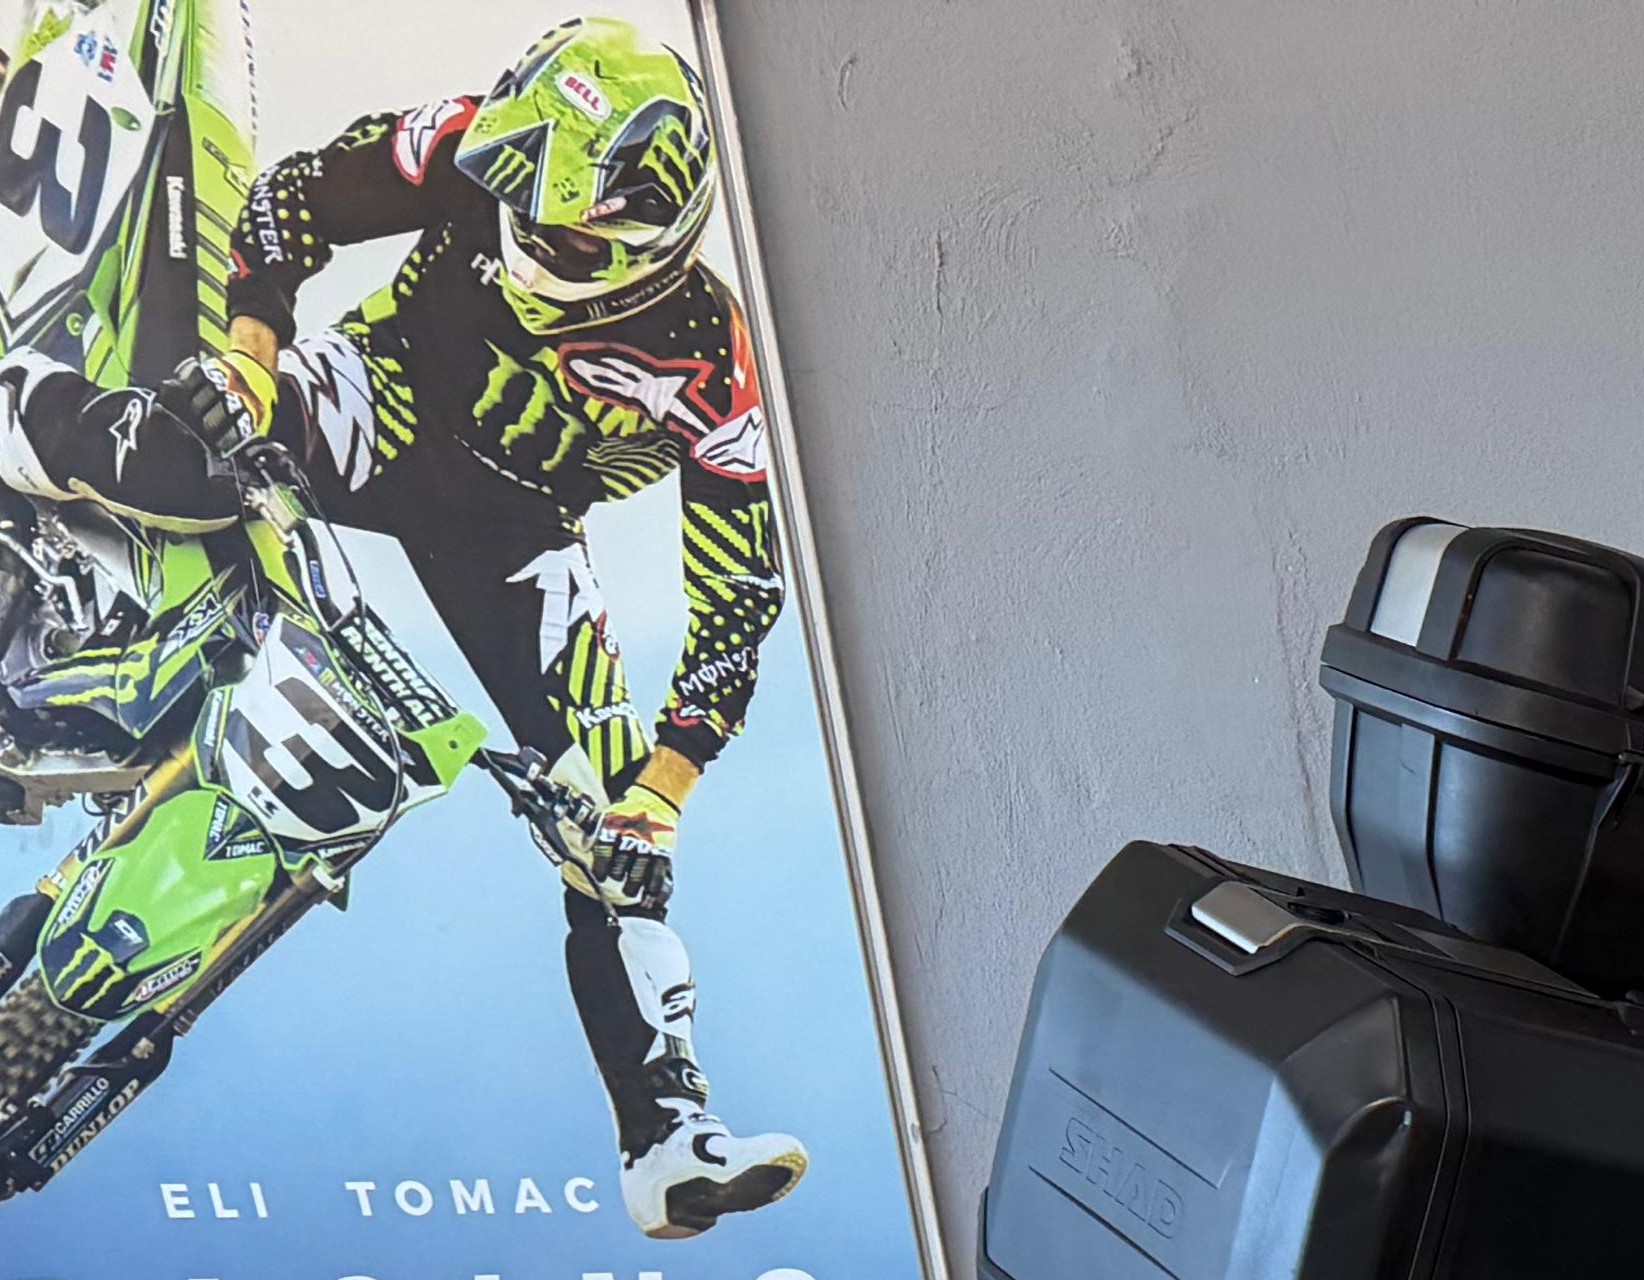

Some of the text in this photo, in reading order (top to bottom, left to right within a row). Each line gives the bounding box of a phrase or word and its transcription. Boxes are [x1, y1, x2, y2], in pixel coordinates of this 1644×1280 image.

[565, 75, 602, 112] BELL
[165, 175, 188, 259] Kawasaki
[224, 676, 410, 835] 3
[50, 1078, 140, 1173] DUNLOP
[55, 1076, 110, 1135] CARRILLO
[159, 1176, 601, 1219] ELI TOMAC
[1058, 1116, 1186, 1240] SHAD
